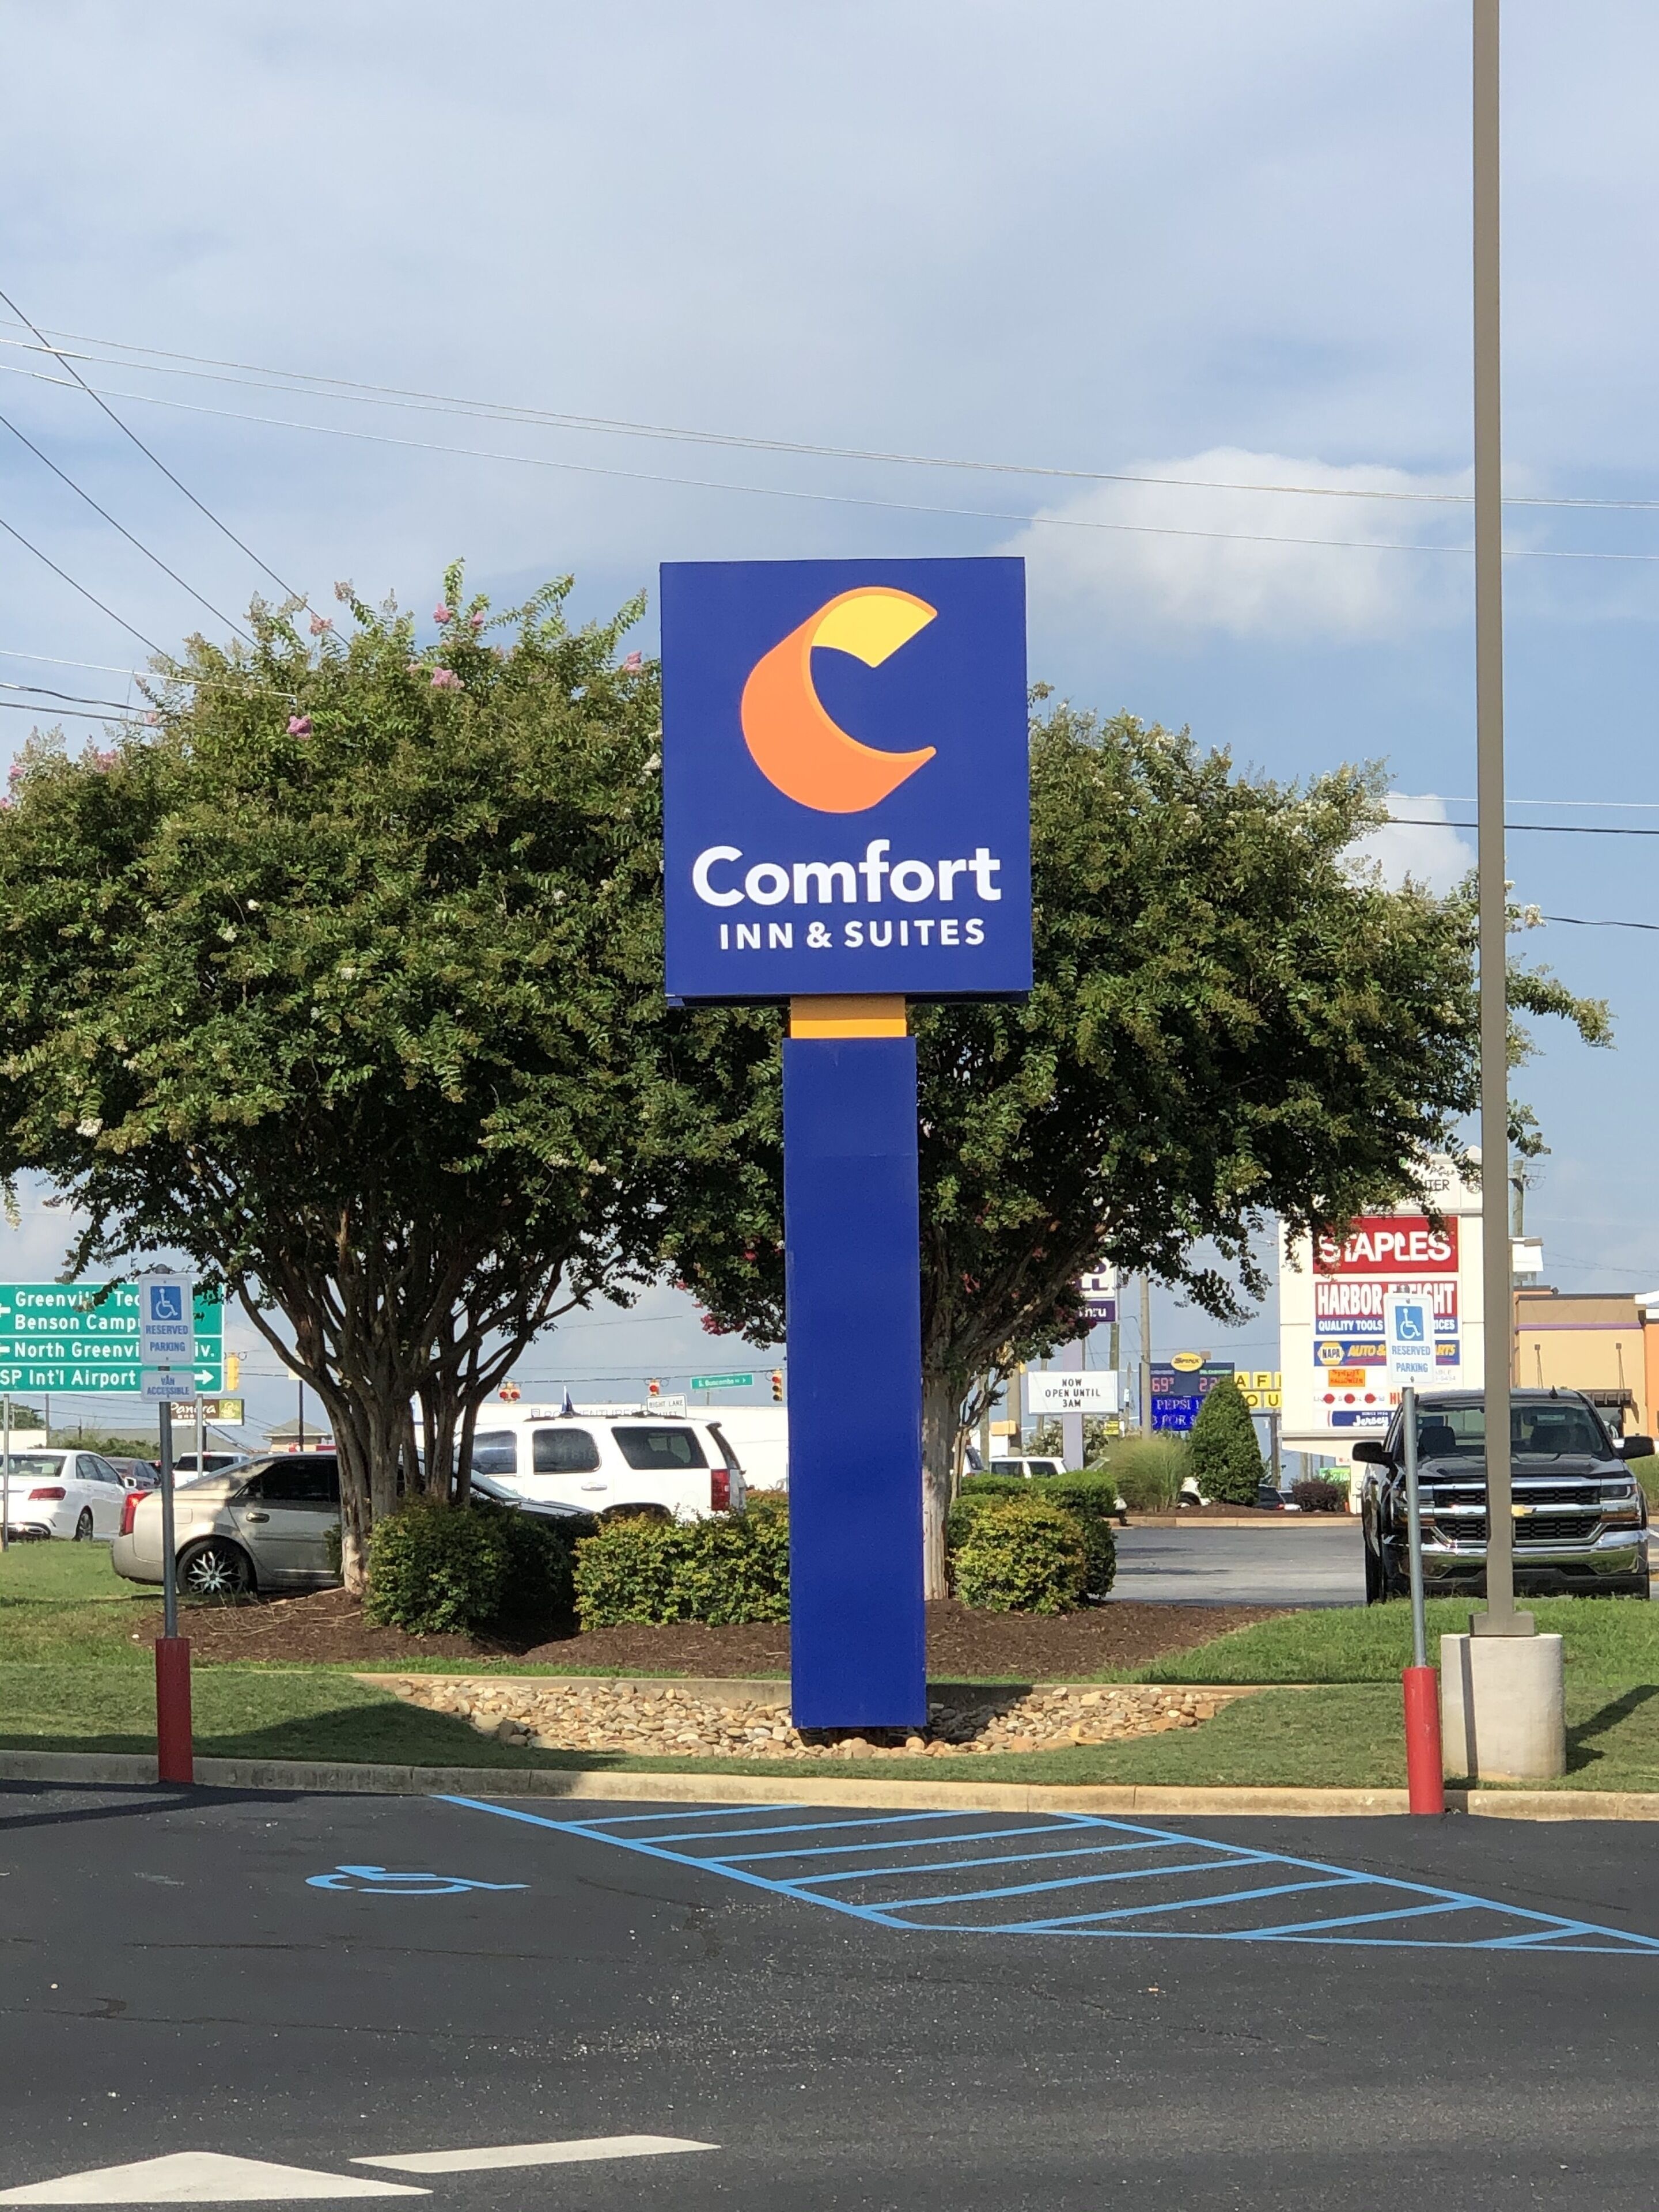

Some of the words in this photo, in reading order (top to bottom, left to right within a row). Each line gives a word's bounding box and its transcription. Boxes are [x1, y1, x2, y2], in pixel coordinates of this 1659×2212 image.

[692, 839, 1001, 907] Comfort
[719, 923, 793, 950] INN
[807, 923, 832, 948] &
[844, 918, 985, 947] SUITES
[1317, 1283, 1383, 1316] HARBOR
[15, 1314, 79, 1330] Benson
[86, 1314, 140, 1332] Camp
[1319, 1320, 1355, 1332] QUALITY
[1355, 1320, 1383, 1331] TOOLS
[146, 1325, 188, 1335] RESERVED
[14, 1342, 65, 1358] North
[71, 1342, 140, 1358] Greenvi
[150, 1342, 185, 1351] PARKING
[1392, 1346, 1431, 1355] RESERVED
[1322, 1349, 1340, 1359] NAPA
[1396, 1362, 1429, 1373] PARKING
[71, 1369, 136, 1388] Airport
[161, 1377, 175, 1385] VAN
[1062, 1378, 1082, 1387] NOW
[147, 1387, 190, 1395] ACCESSIBLE
[1045, 1389, 1069, 1397] OPEN
[1073, 1389, 1100, 1397] UNTIL
[1062, 1400, 1081, 1408] 3AM
[1352, 1415, 1389, 1427] Jersey
